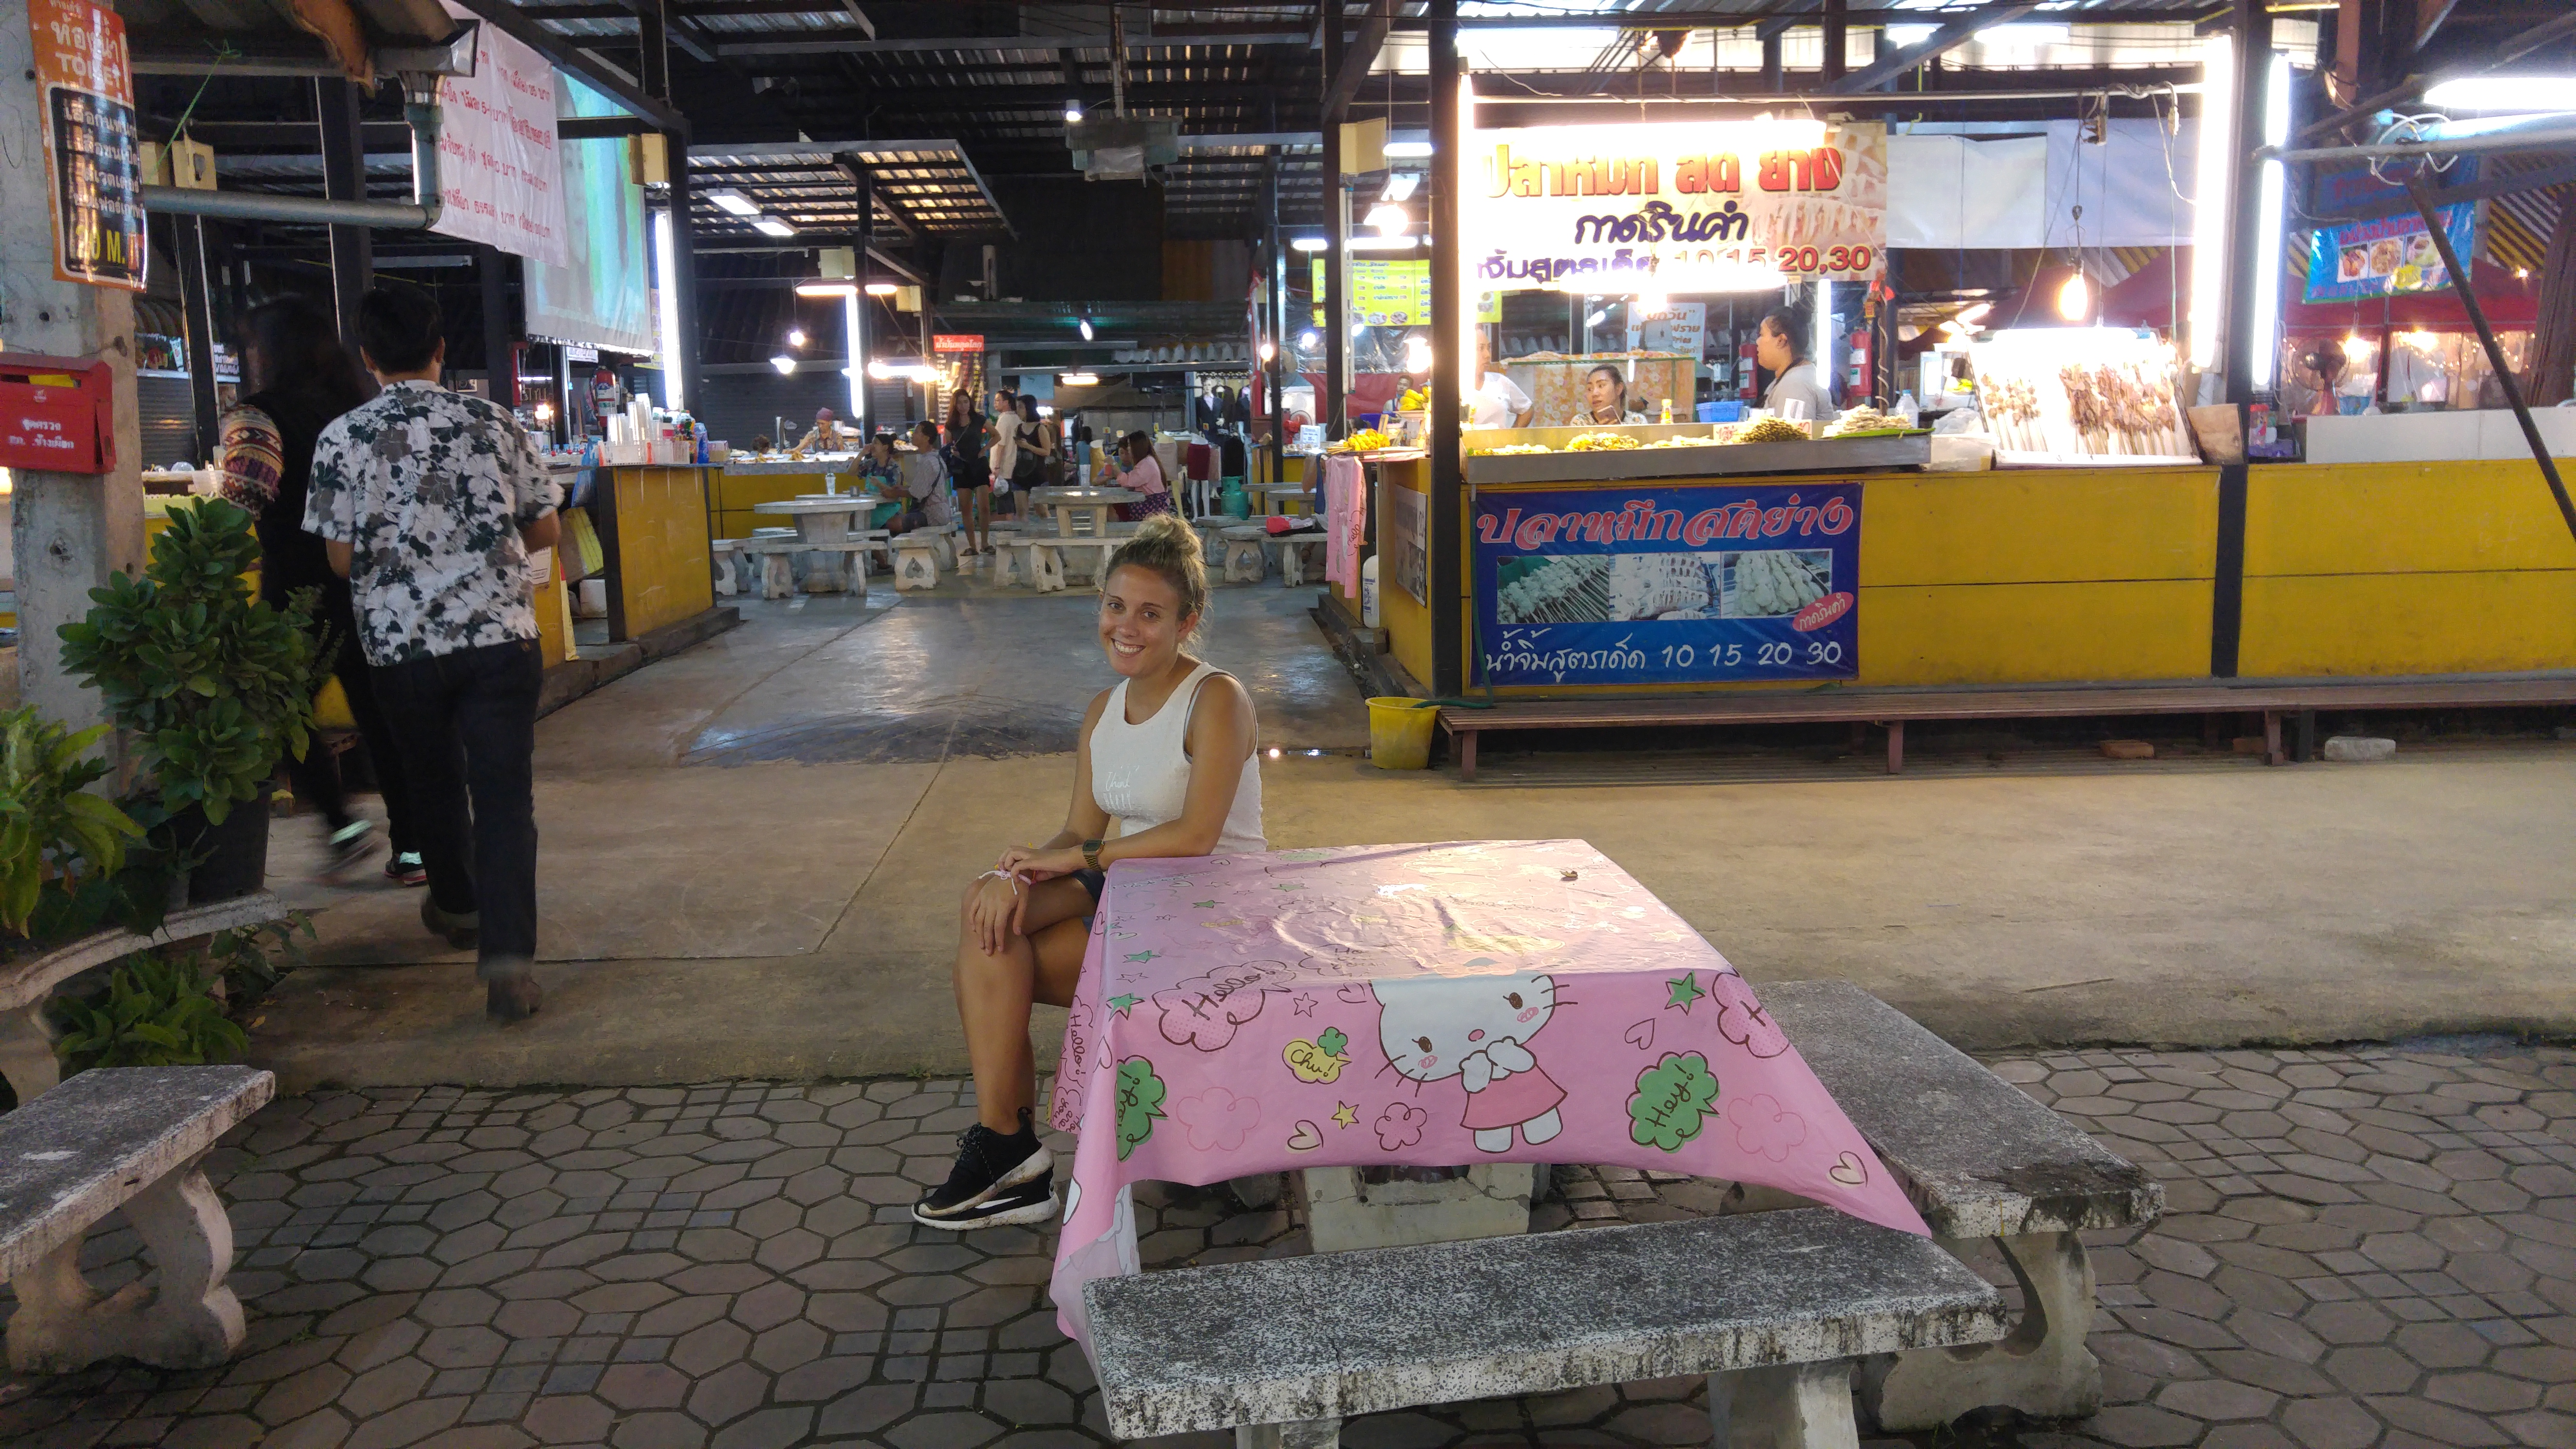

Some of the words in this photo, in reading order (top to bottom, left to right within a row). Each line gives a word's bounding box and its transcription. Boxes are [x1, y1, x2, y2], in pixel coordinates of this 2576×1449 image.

[55, 51, 121, 89] TOIET
[1662, 644, 1695, 668] 10
[1709, 644, 1743, 667] 15
[1758, 642, 1793, 665] 20
[1807, 641, 1842, 665] 30
[1290, 1049, 1335, 1078] Chu!
[1117, 1070, 1140, 1138] ey!
[1644, 1063, 1694, 1127] Hey!
